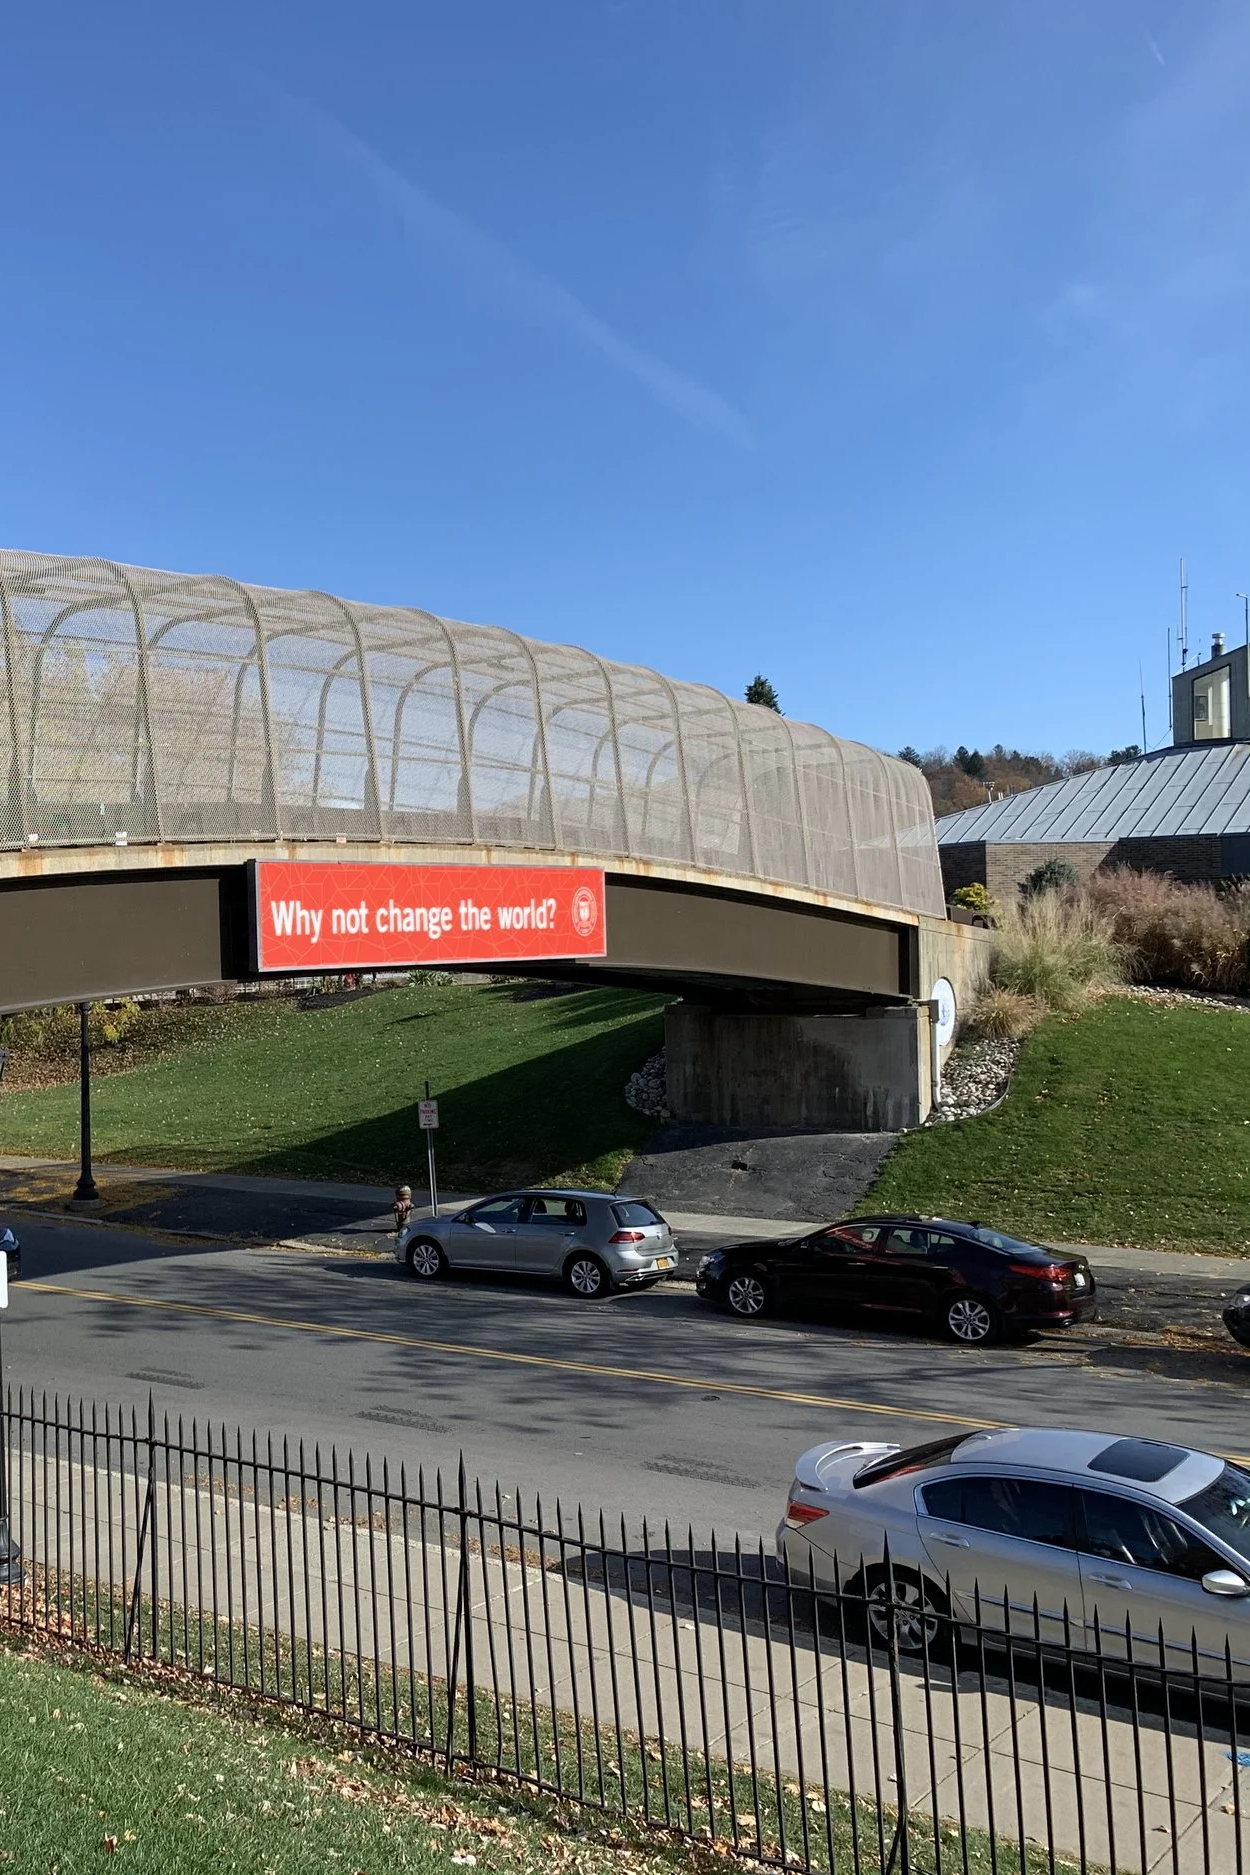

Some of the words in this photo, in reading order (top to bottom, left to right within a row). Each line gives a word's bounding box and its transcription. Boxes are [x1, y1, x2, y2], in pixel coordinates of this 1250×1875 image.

[271, 900, 323, 944] Why
[331, 900, 369, 934] not
[376, 899, 452, 939] change
[459, 898, 491, 931] the
[497, 898, 556, 930] world?
